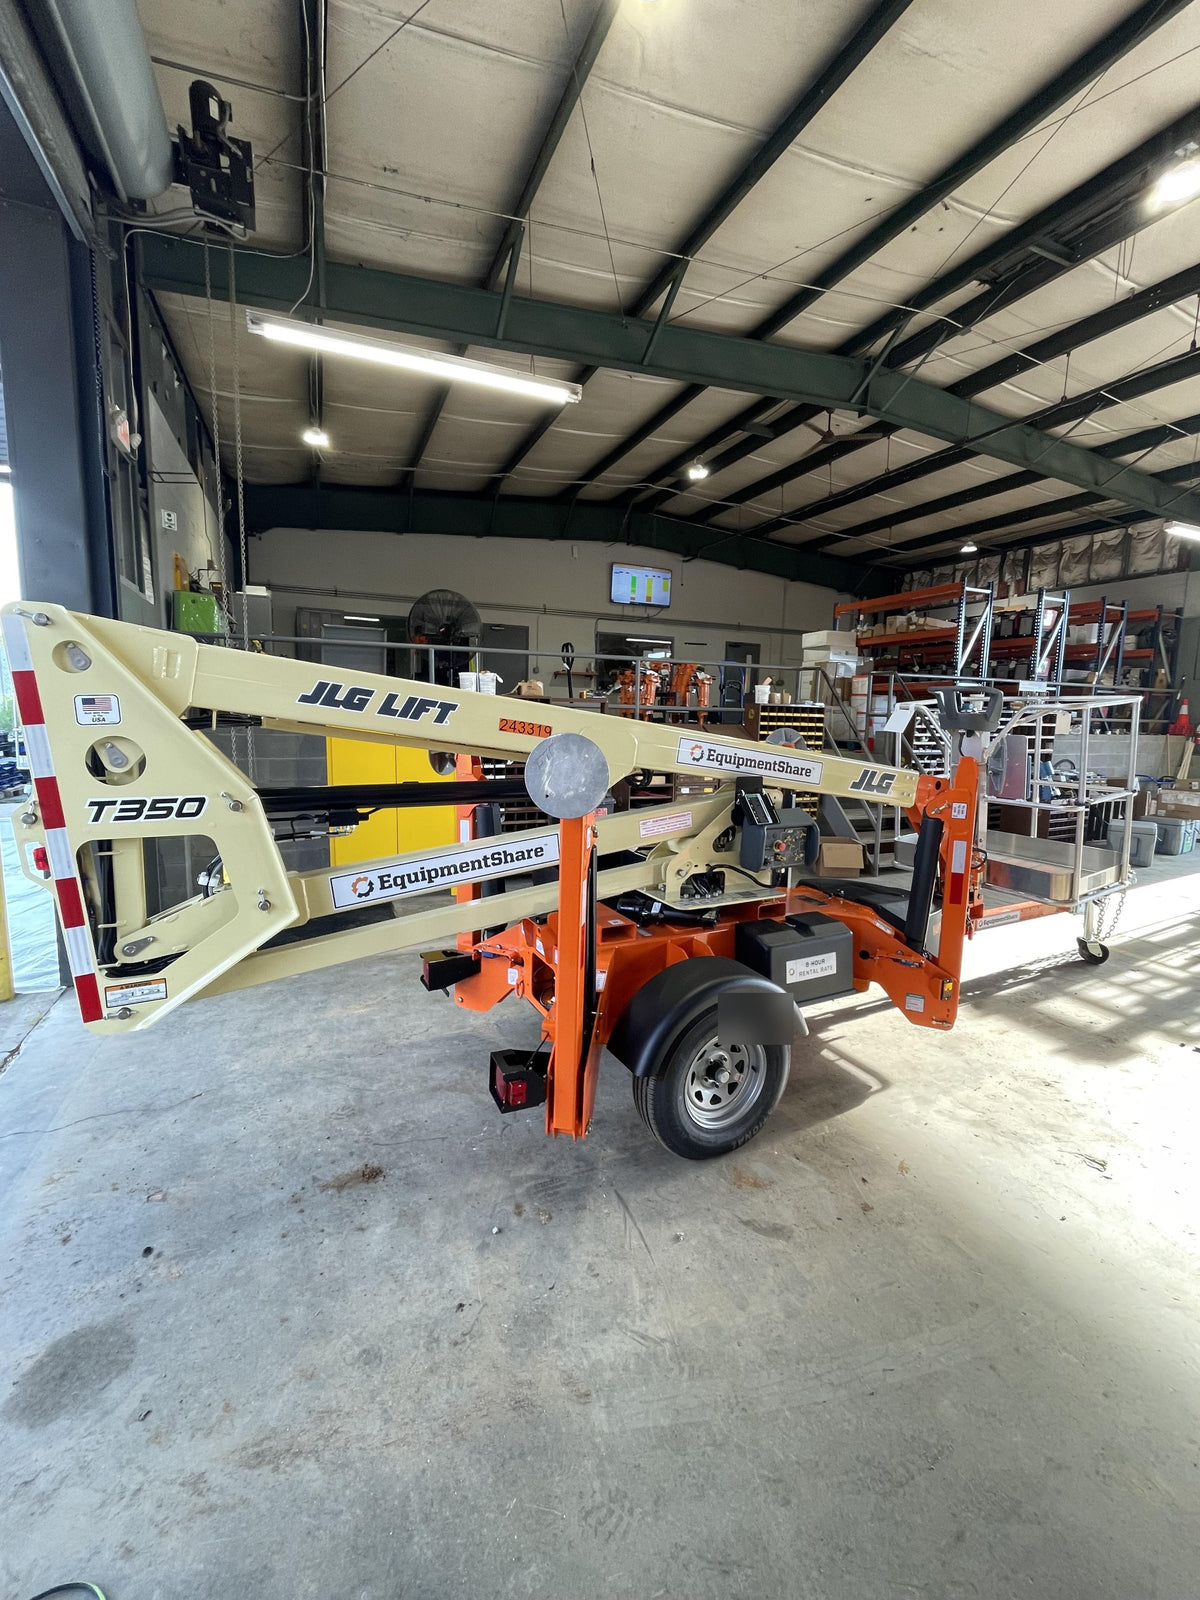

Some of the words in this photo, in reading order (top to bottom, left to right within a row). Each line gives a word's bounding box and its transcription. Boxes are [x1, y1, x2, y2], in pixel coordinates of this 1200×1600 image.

[297, 680, 376, 713] JLG
[376, 692, 459, 725] LIFT
[499, 718, 552, 736] 243319
[706, 748, 812, 777] EquipmentShare
[849, 768, 897, 795] JLG
[87, 796, 206, 823] T350
[378, 845, 545, 891] EquipmentShare
[798, 968, 819, 977] RENTAL
[810, 958, 826, 966] HOUR
